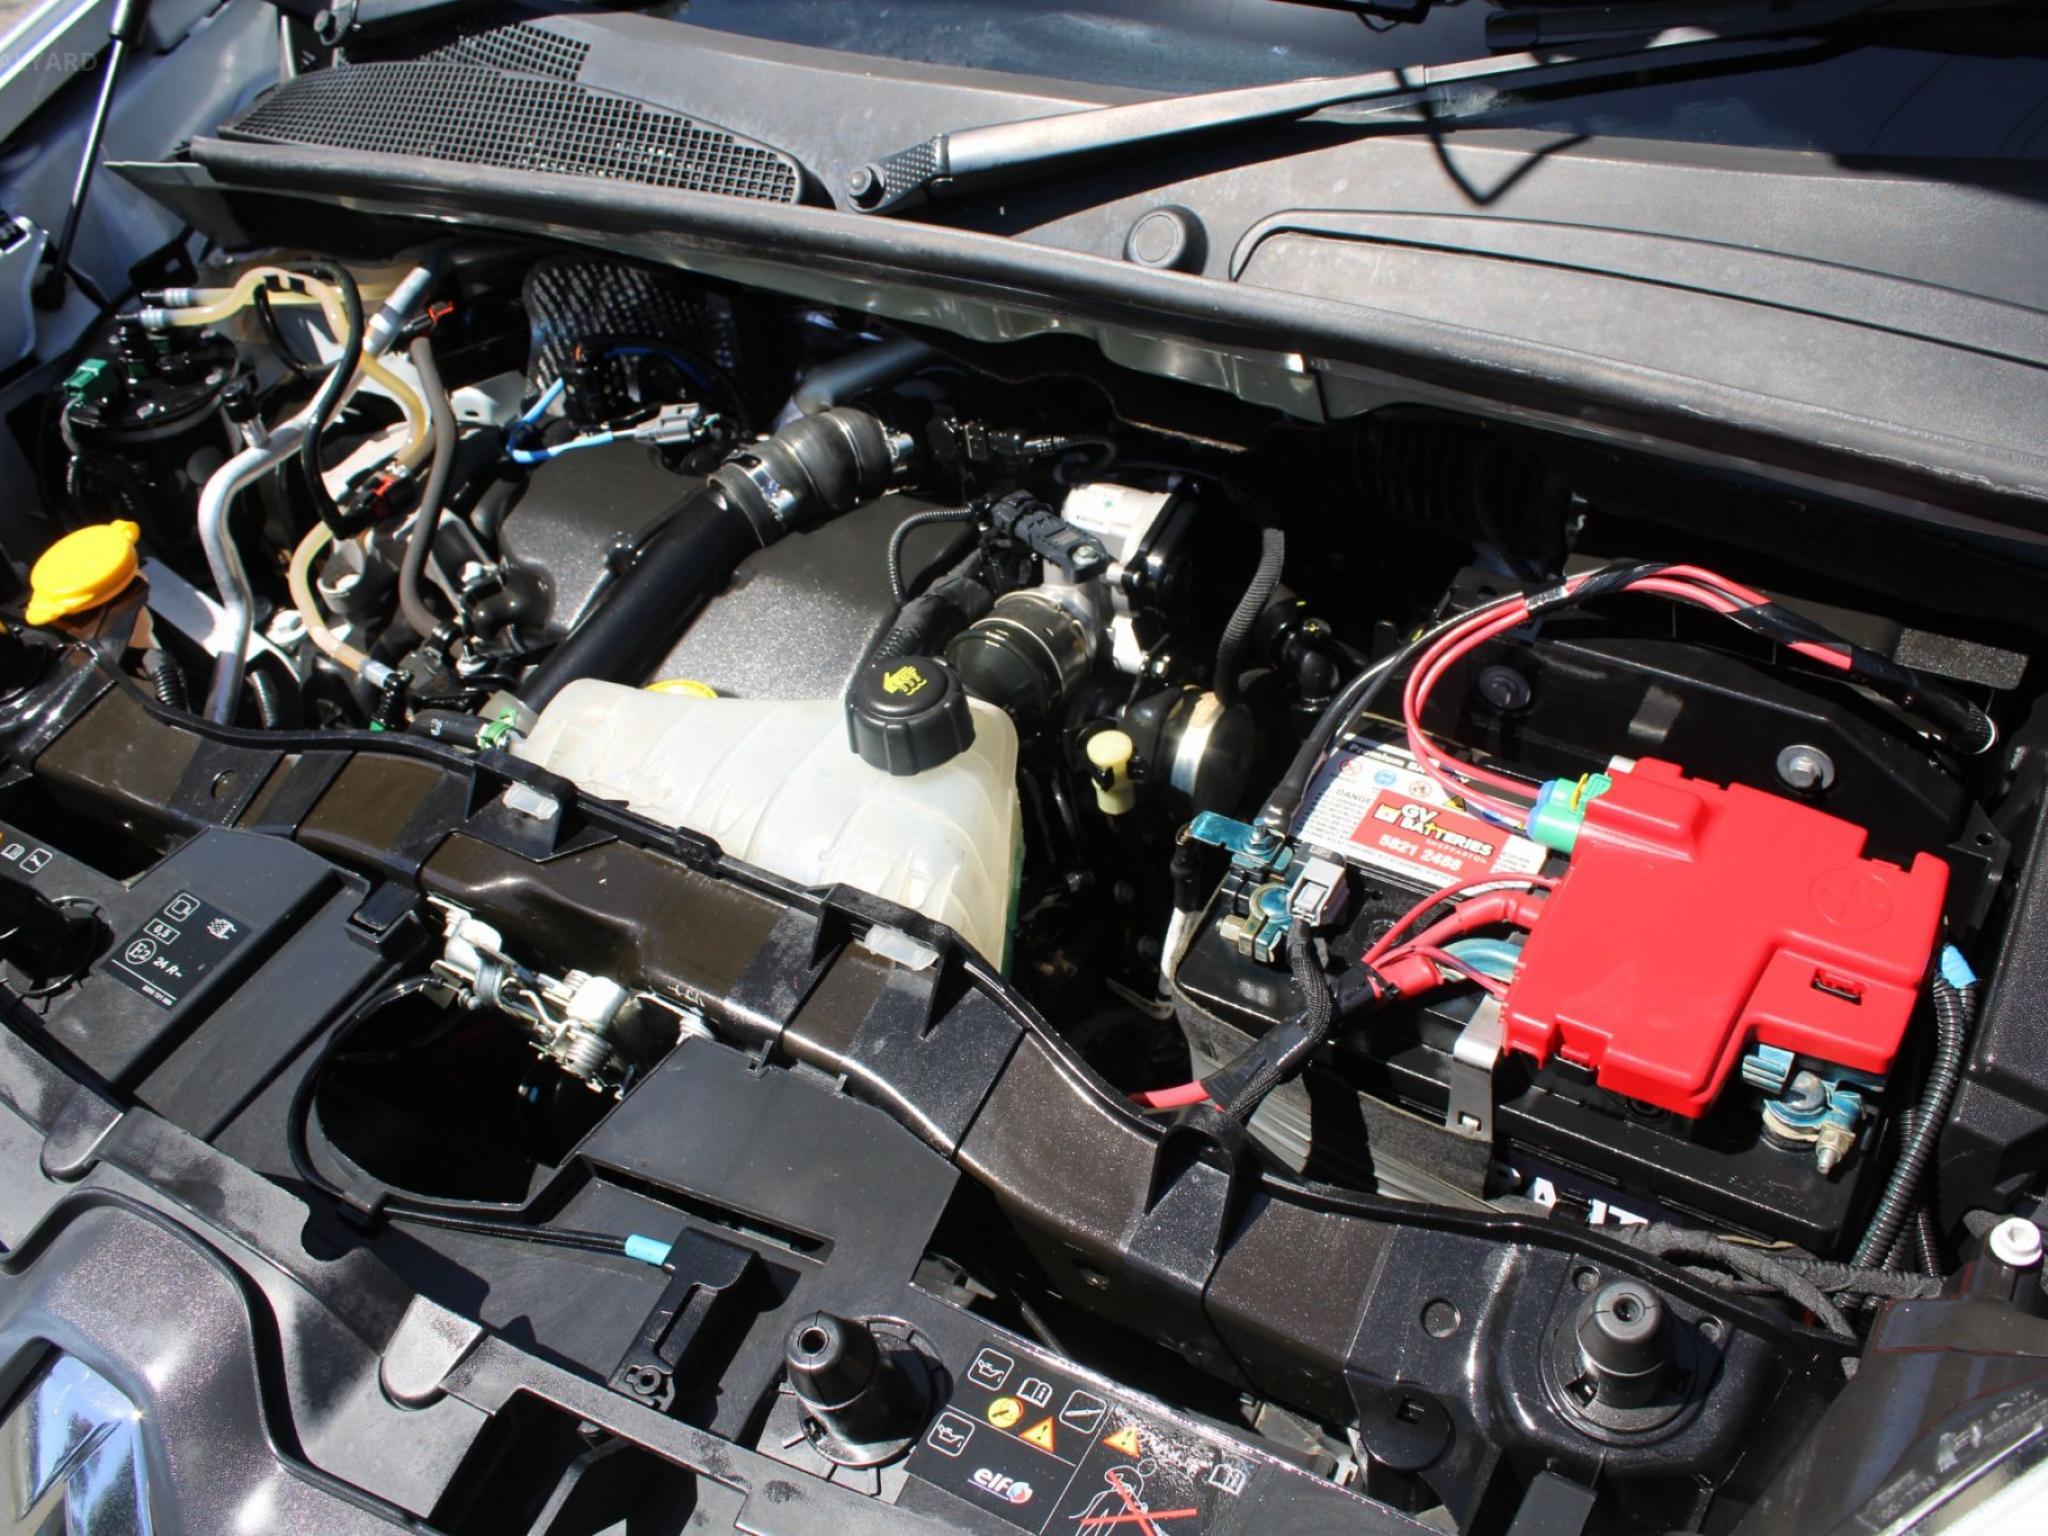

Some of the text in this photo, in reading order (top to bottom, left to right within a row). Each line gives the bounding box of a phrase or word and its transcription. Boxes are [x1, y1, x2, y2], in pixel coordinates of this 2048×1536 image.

[1400, 803, 1439, 824] GV
[1400, 817, 1493, 856] BATTERIES
[973, 1467, 1015, 1493] elf
